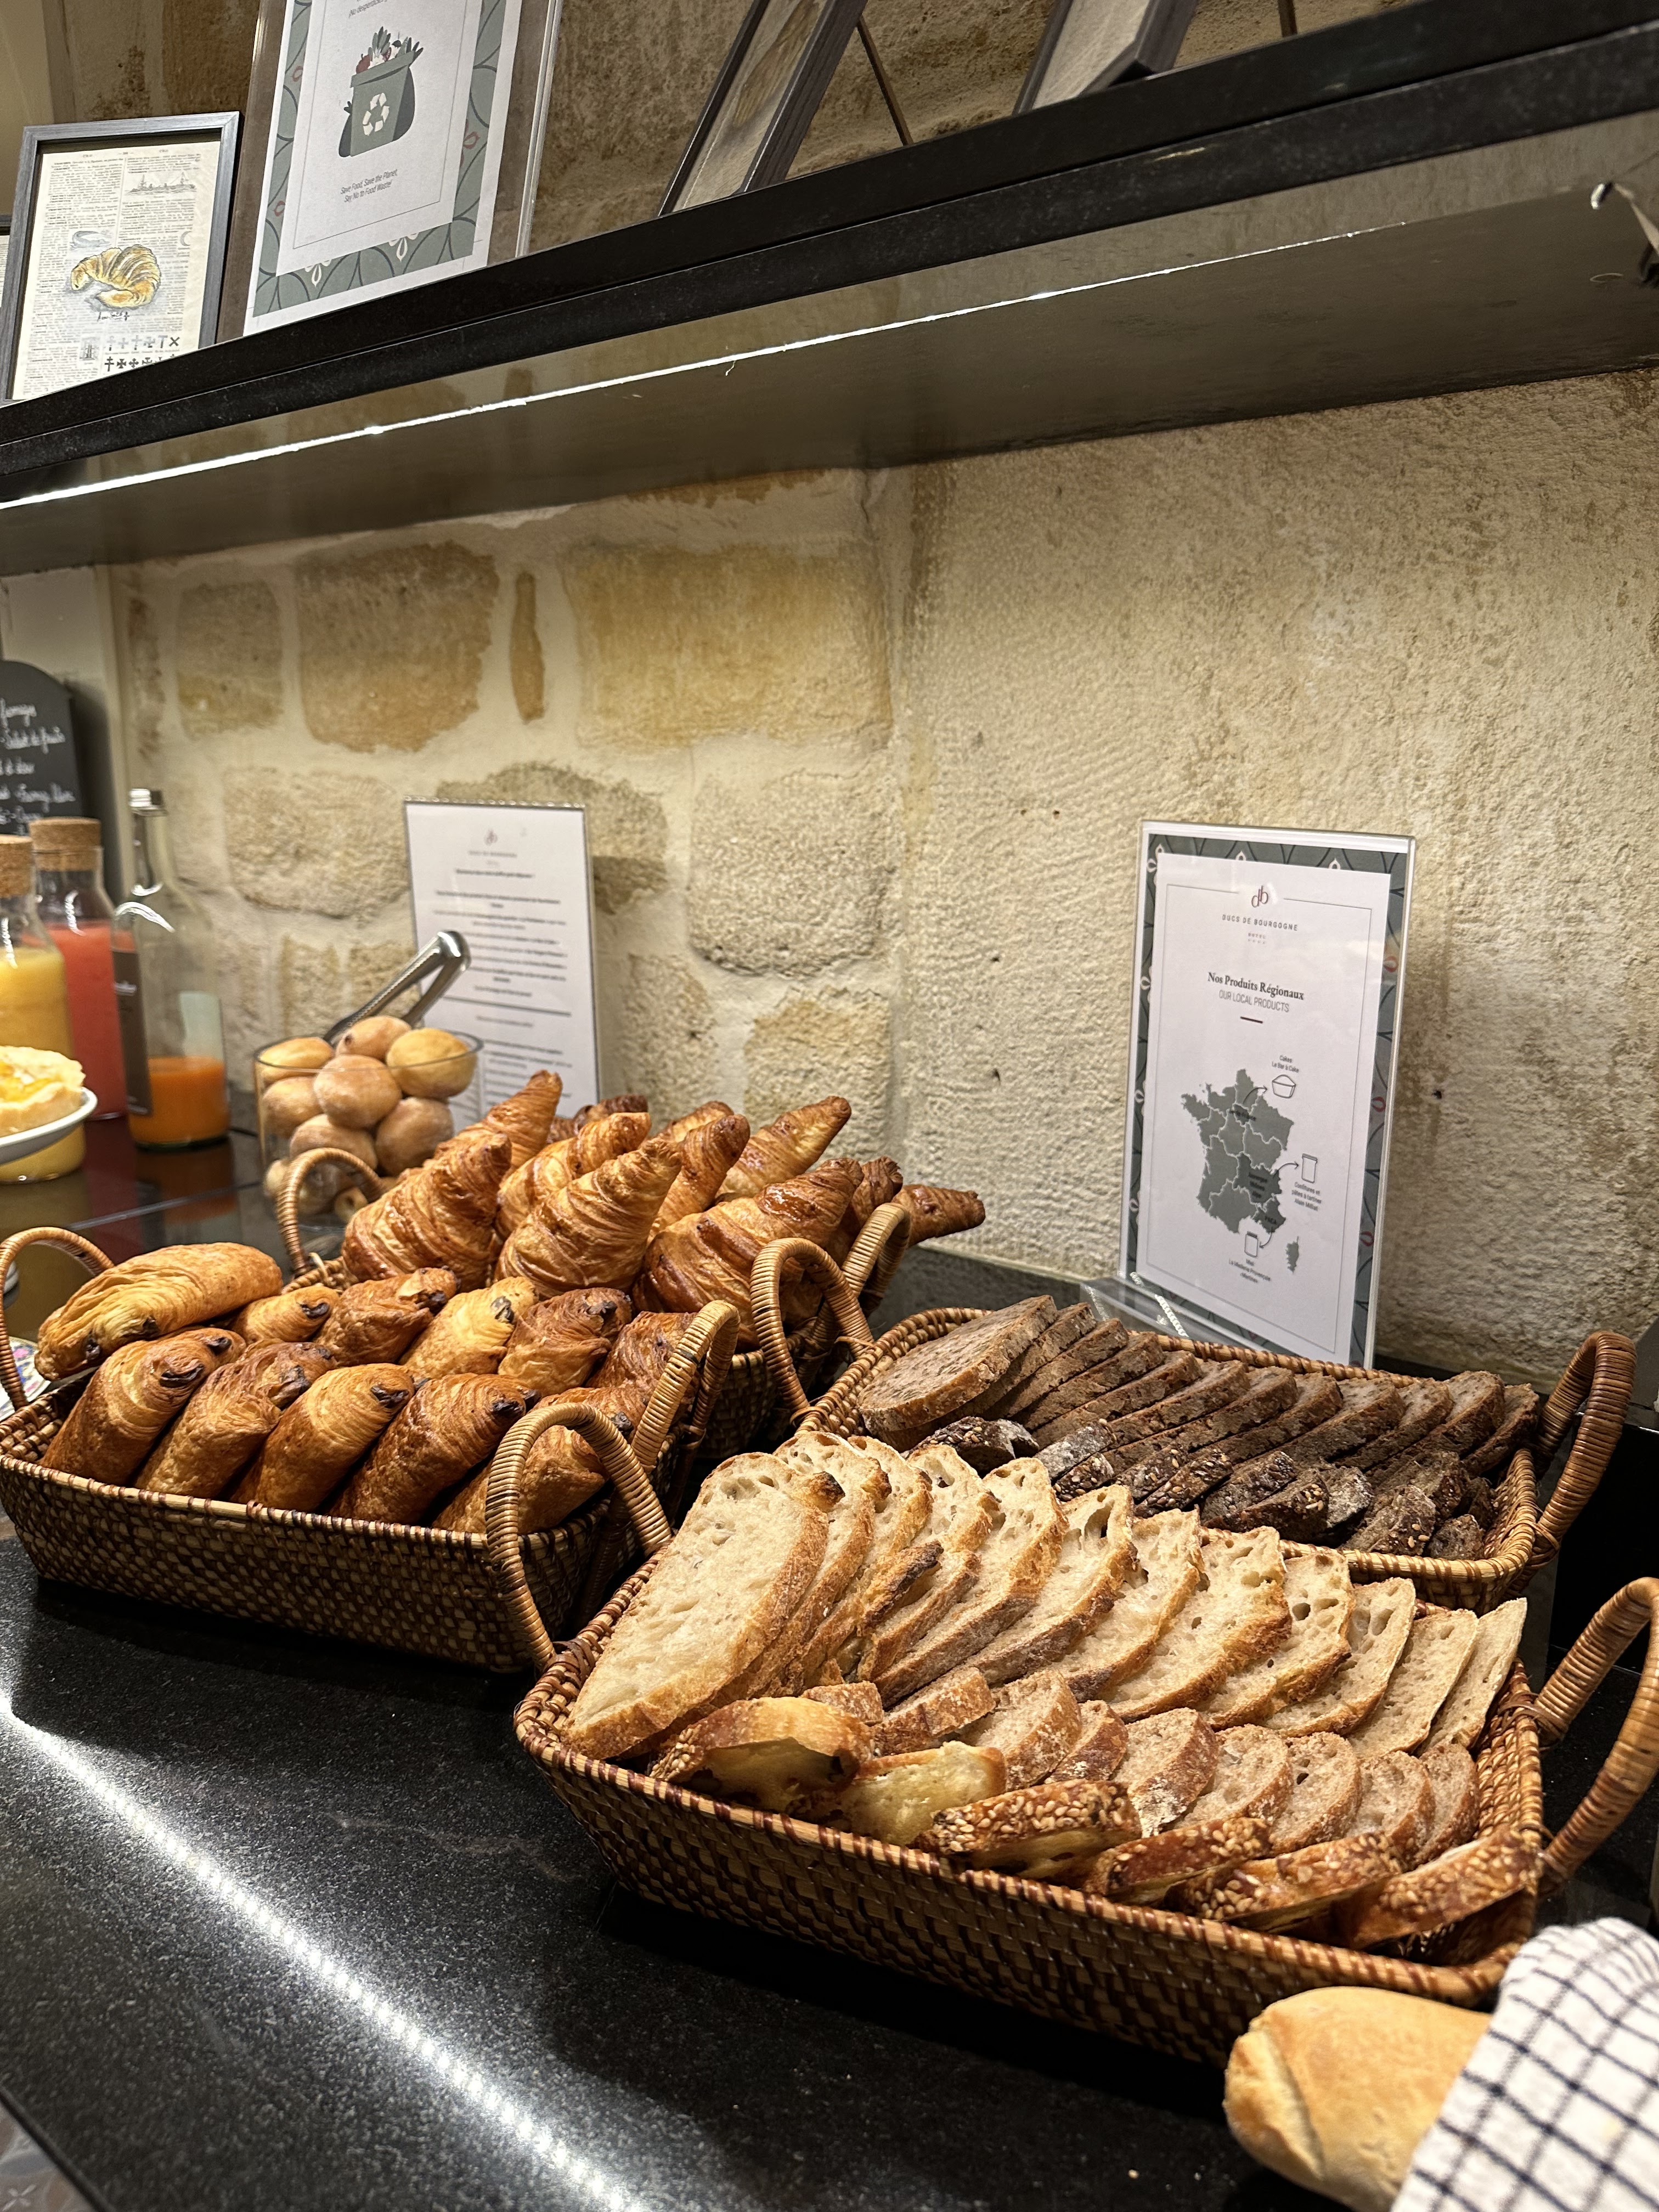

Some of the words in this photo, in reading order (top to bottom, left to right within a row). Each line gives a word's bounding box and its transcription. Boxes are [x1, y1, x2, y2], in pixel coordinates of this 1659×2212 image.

[1222, 913, 1240, 923] DUCS
[1254, 918, 1299, 932] BOURGOGNE
[1207, 972, 1223, 984] Nos
[1224, 975, 1258, 991] Produits
[1260, 981, 1305, 1001] Régionaux
[1218, 989, 1232, 1002] OUR
[1233, 992, 1252, 1006] LOCAL
[1254, 997, 1290, 1013] PRODUCTS
